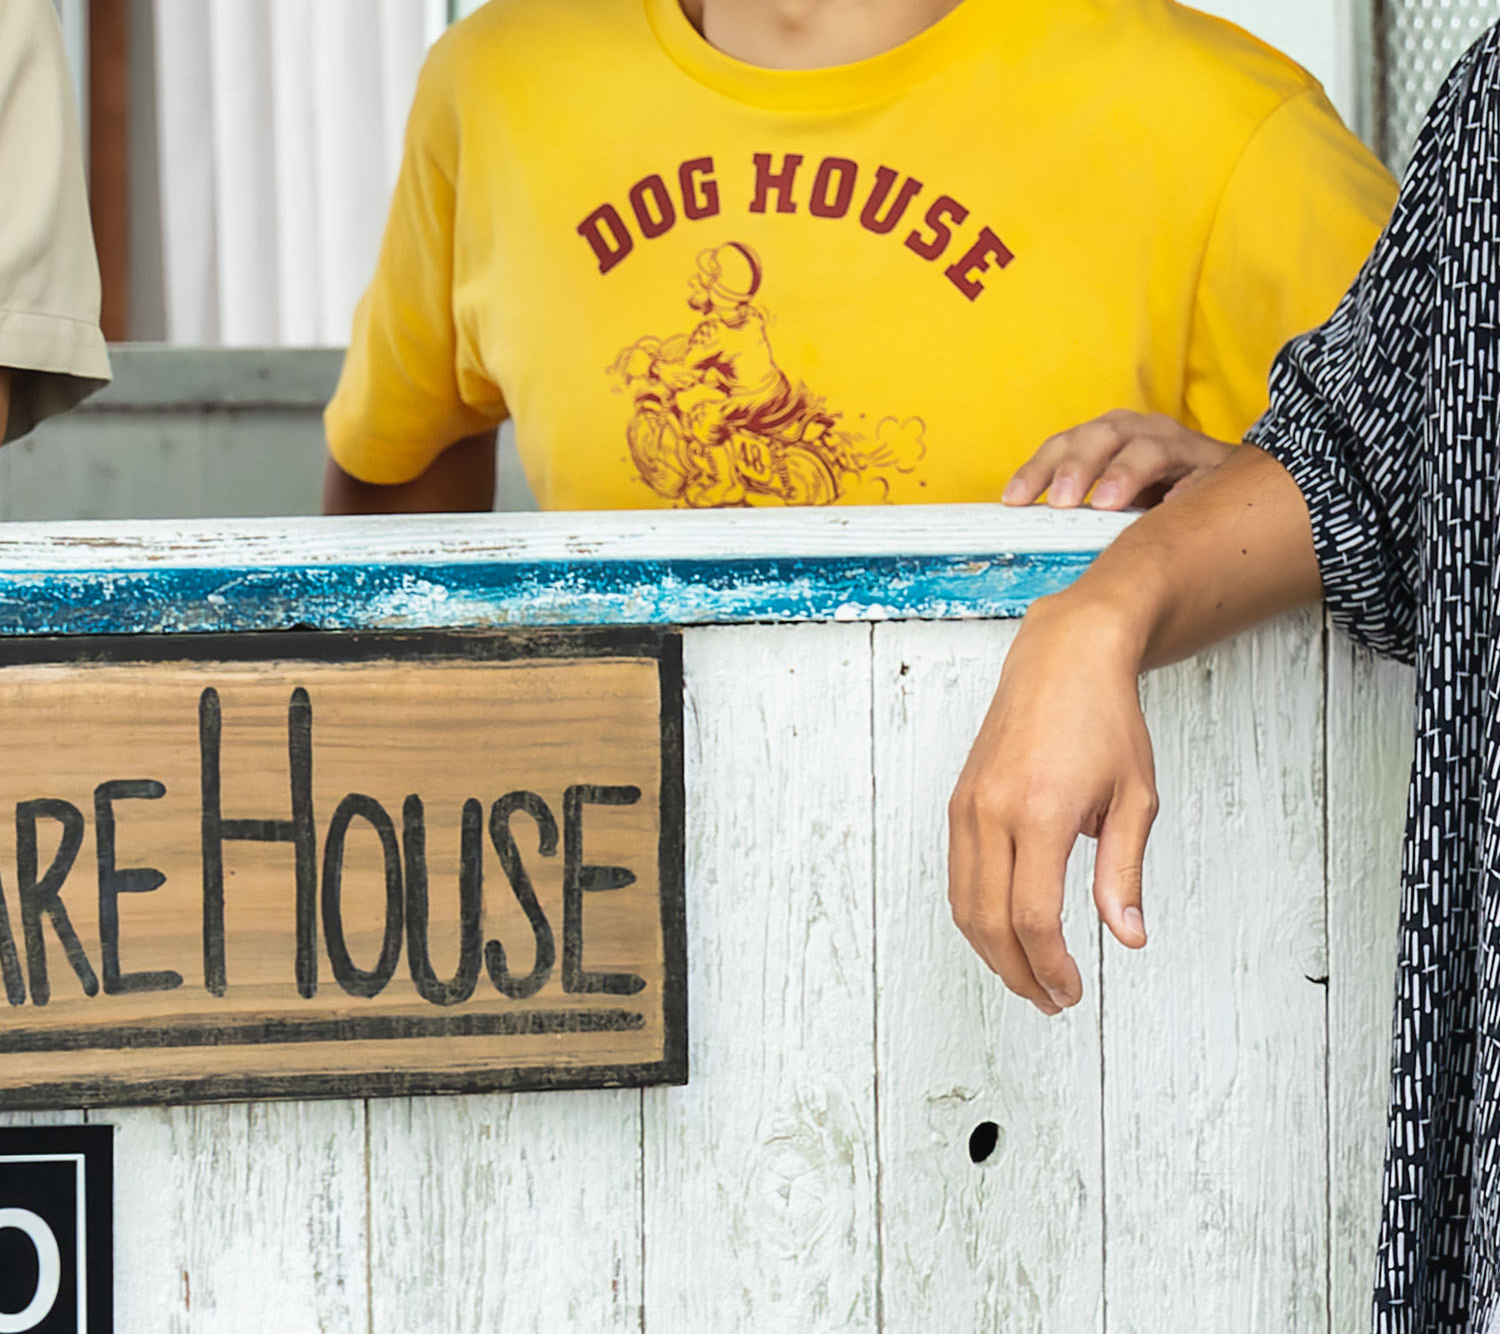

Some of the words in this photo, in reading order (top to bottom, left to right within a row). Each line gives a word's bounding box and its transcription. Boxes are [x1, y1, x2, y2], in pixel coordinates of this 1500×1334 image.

[576, 156, 720, 275] DOG
[749, 152, 1015, 302] HOUSE
[197, 686, 647, 1007] HOUSE
